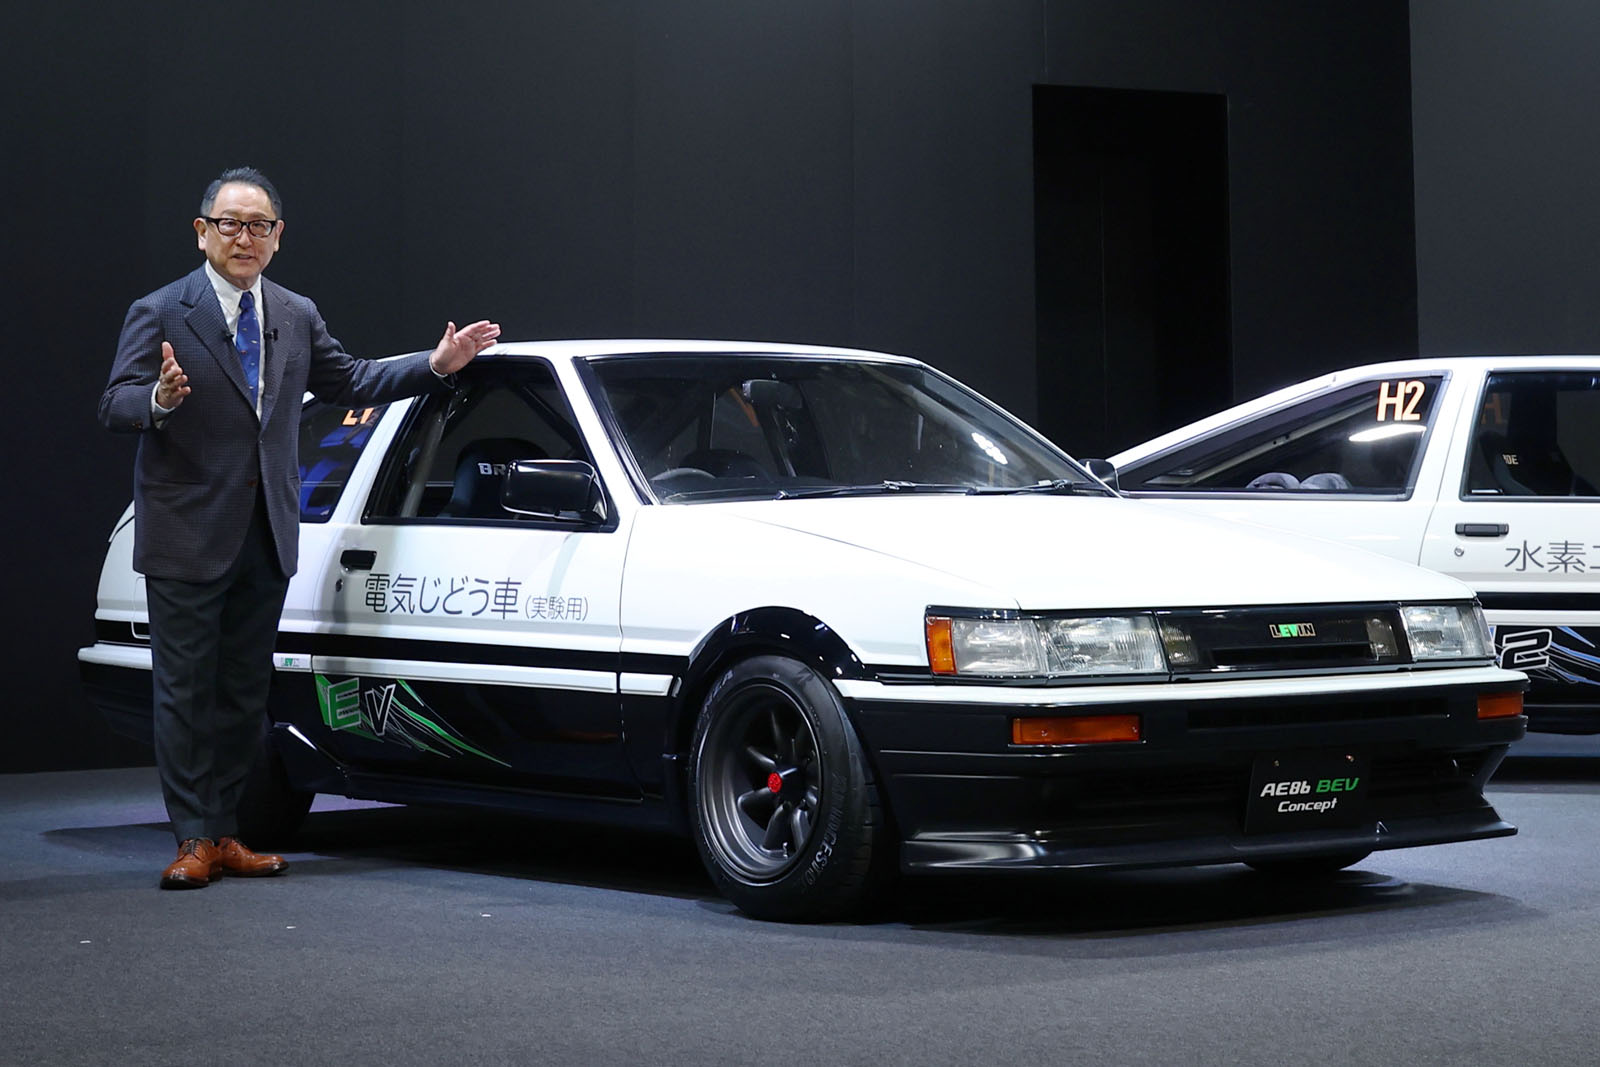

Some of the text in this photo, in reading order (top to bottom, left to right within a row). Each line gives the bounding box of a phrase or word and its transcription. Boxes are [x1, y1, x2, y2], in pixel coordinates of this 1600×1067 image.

[1376, 380, 1426, 422] H2
[1504, 539, 1600, 574] 水素
[1269, 622, 1316, 638] LEVIN
[1316, 777, 1360, 793] BEV
[1277, 797, 1337, 813] Concept
